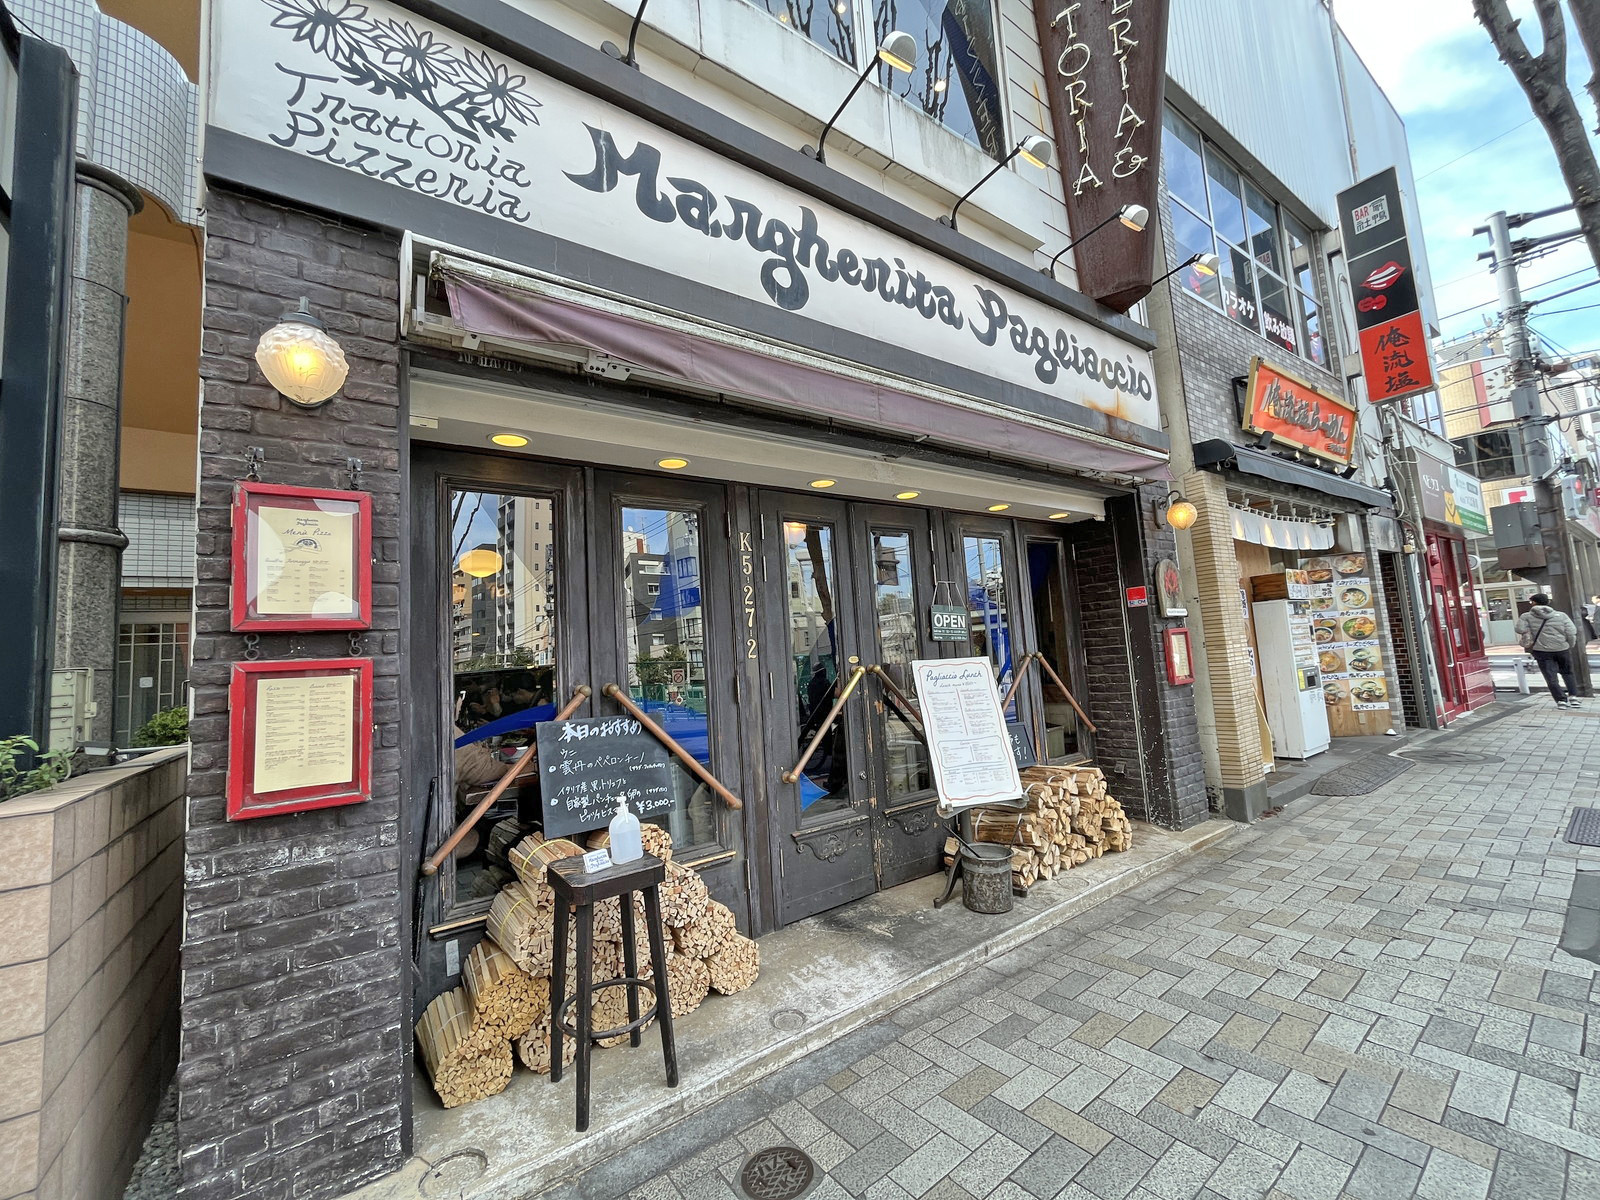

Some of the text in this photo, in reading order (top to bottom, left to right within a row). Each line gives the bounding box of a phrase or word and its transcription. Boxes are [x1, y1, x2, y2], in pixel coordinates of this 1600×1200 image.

[274, 62, 531, 188] Trattoria
[268, 109, 531, 223] Pizzeria
[1354, 206, 1369, 221] BAR
[561, 121, 1152, 402] Margherita Pagliaccio
[1374, 326, 1420, 393] 俺流塩
[933, 613, 966, 628] OPEN
[558, 718, 642, 743] 本日のおすすめ
[560, 748, 577, 759] ウニ
